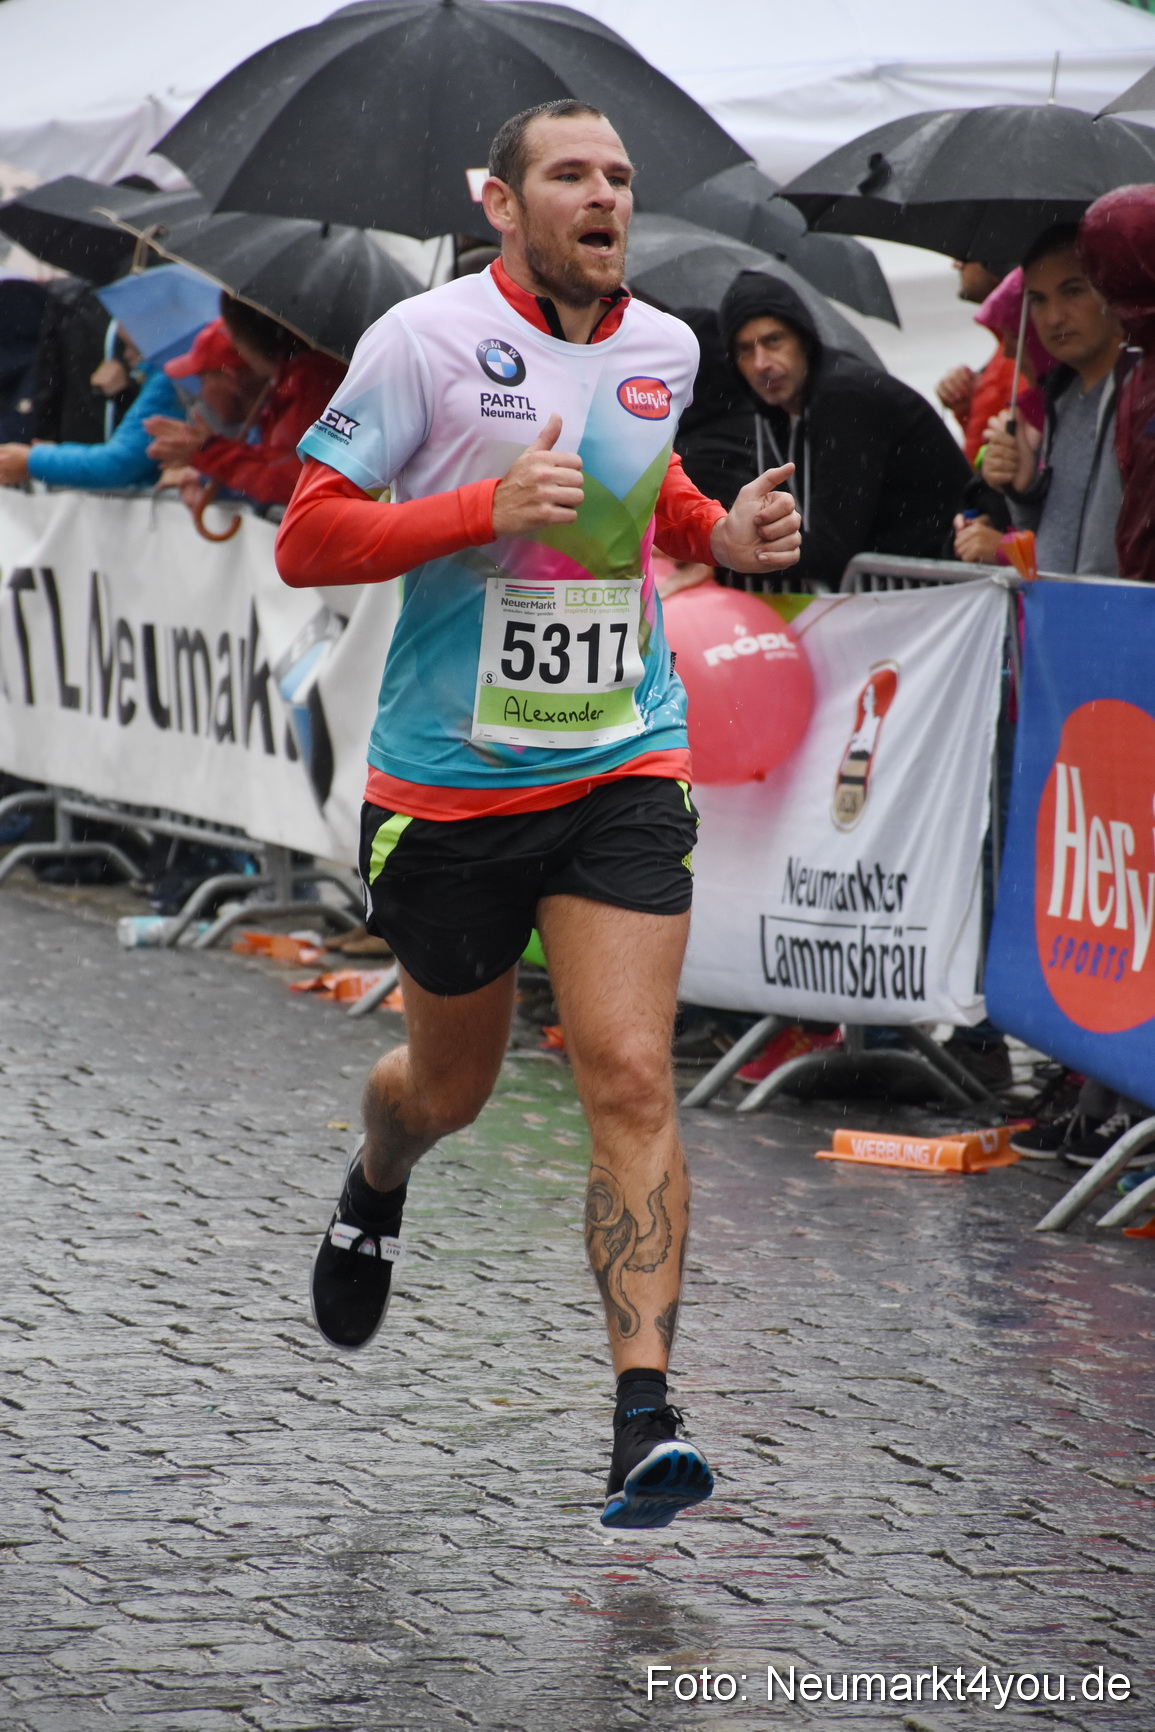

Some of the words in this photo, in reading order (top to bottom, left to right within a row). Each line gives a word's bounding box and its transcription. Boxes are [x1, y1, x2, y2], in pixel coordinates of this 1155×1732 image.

[478, 340, 520, 360] BMW
[480, 392, 536, 411] PARTL
[625, 386, 668, 409] Hervis
[480, 406, 537, 422] Neumarkt
[500, 597, 557, 610] NeuerMarkt
[565, 587, 631, 606] BOCK
[501, 620, 628, 684] 5317
[504, 695, 604, 724] Alexander
[1046, 762, 1155, 972] Herv
[781, 856, 908, 912] Neumarkter
[760, 914, 926, 1001] Lammsbräu
[1048, 935, 1129, 982] SPORTS
[850, 1138, 931, 1163] WERBUNG
